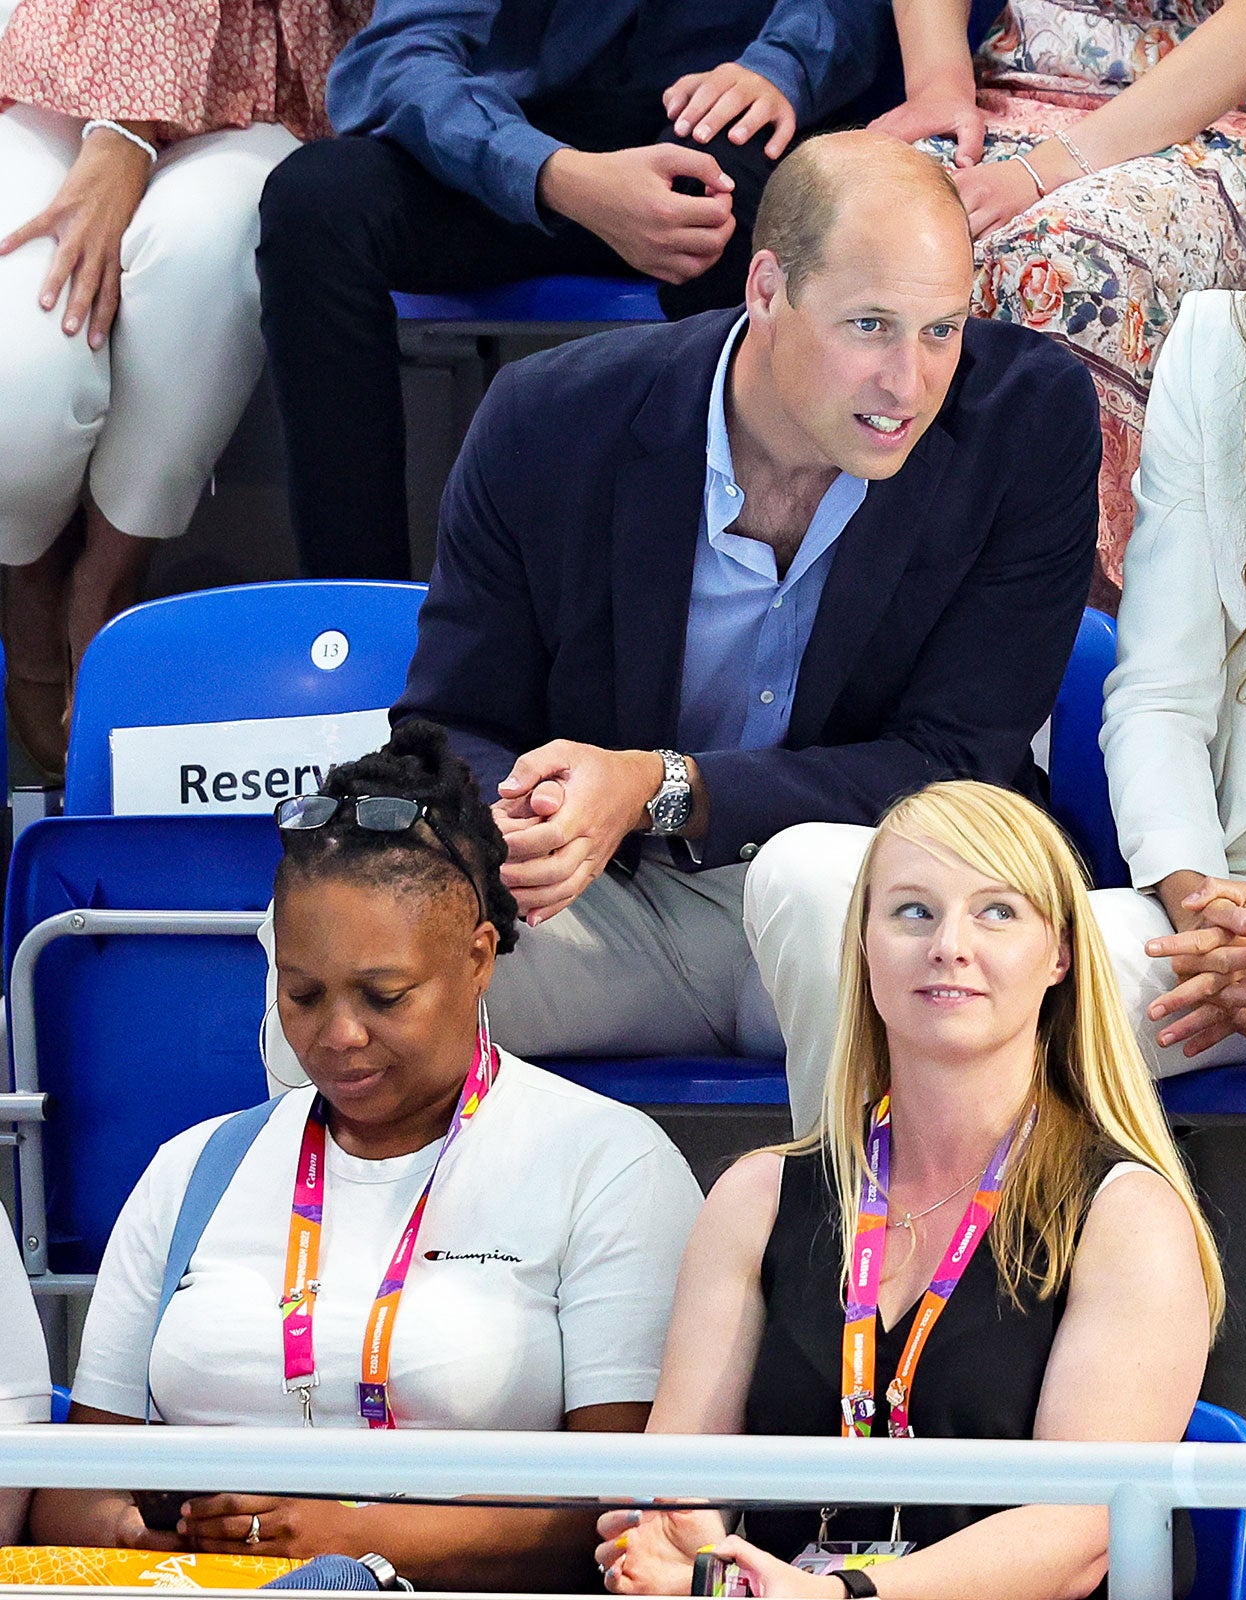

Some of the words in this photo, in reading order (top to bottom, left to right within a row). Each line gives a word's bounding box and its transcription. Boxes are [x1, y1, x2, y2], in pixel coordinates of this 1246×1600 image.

[323, 643, 339, 657] 13
[305, 1152, 317, 1189] Canon
[951, 1224, 977, 1263] Canon
[423, 1249, 522, 1264] Champion
[858, 1247, 872, 1287] Canon
[919, 1308, 934, 1327] 2022
[369, 1354, 379, 1375] 2022
